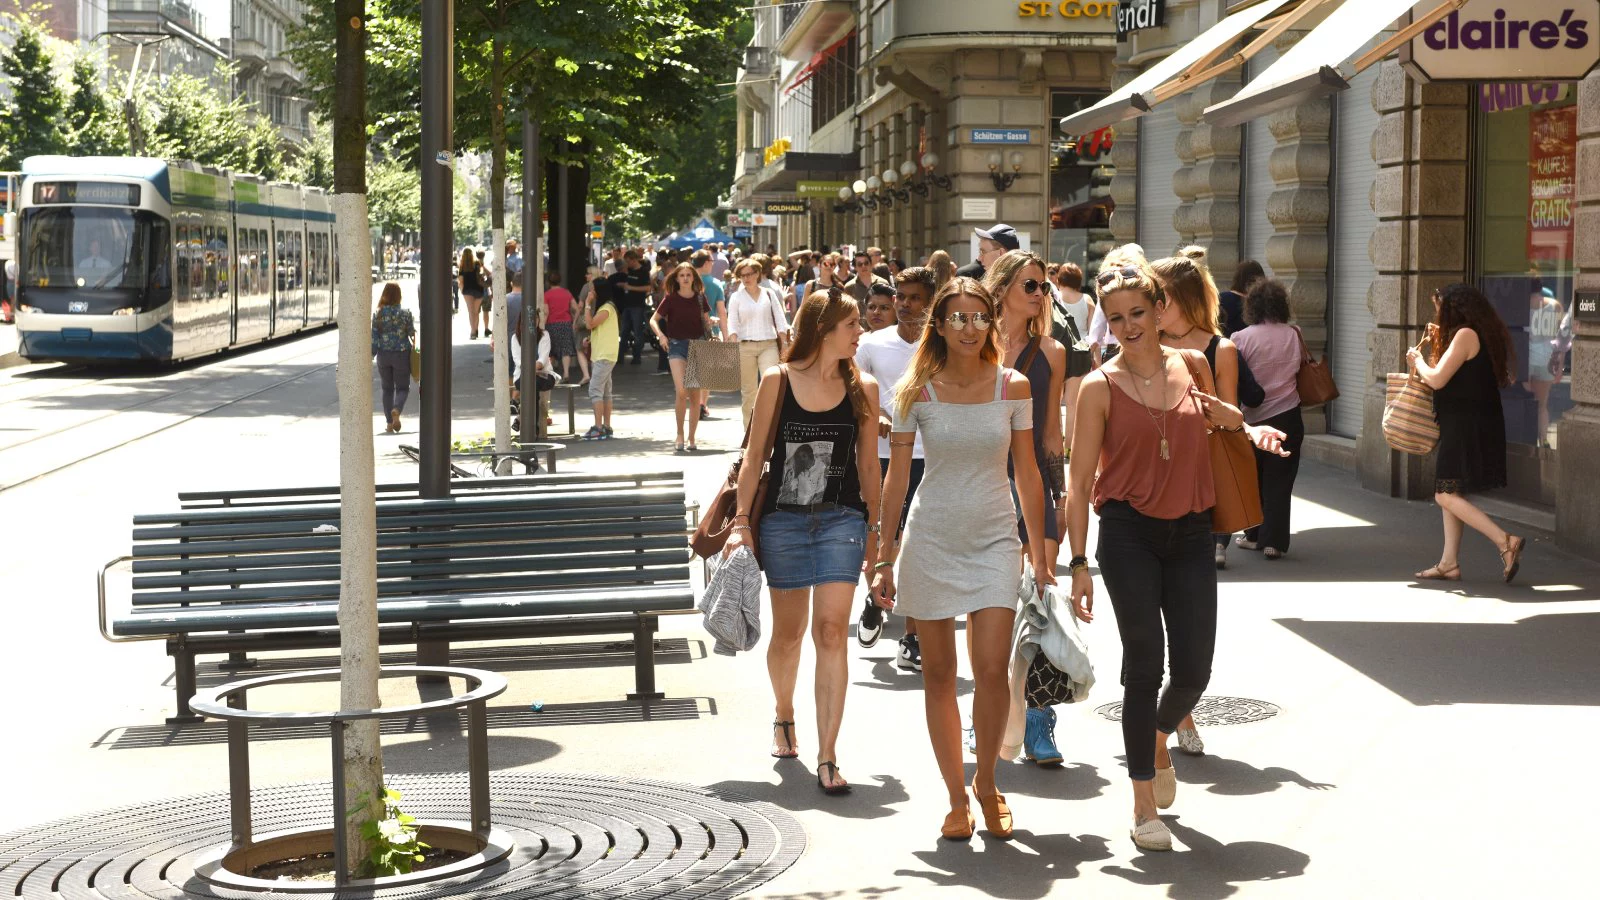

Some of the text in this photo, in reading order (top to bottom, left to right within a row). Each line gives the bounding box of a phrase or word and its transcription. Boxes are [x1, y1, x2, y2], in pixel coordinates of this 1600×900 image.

[1423, 8, 1589, 51] claire's
[41, 185, 56, 198] 17
[1530, 198, 1572, 228] GRATIS
[1579, 299, 1596, 312] claire's
